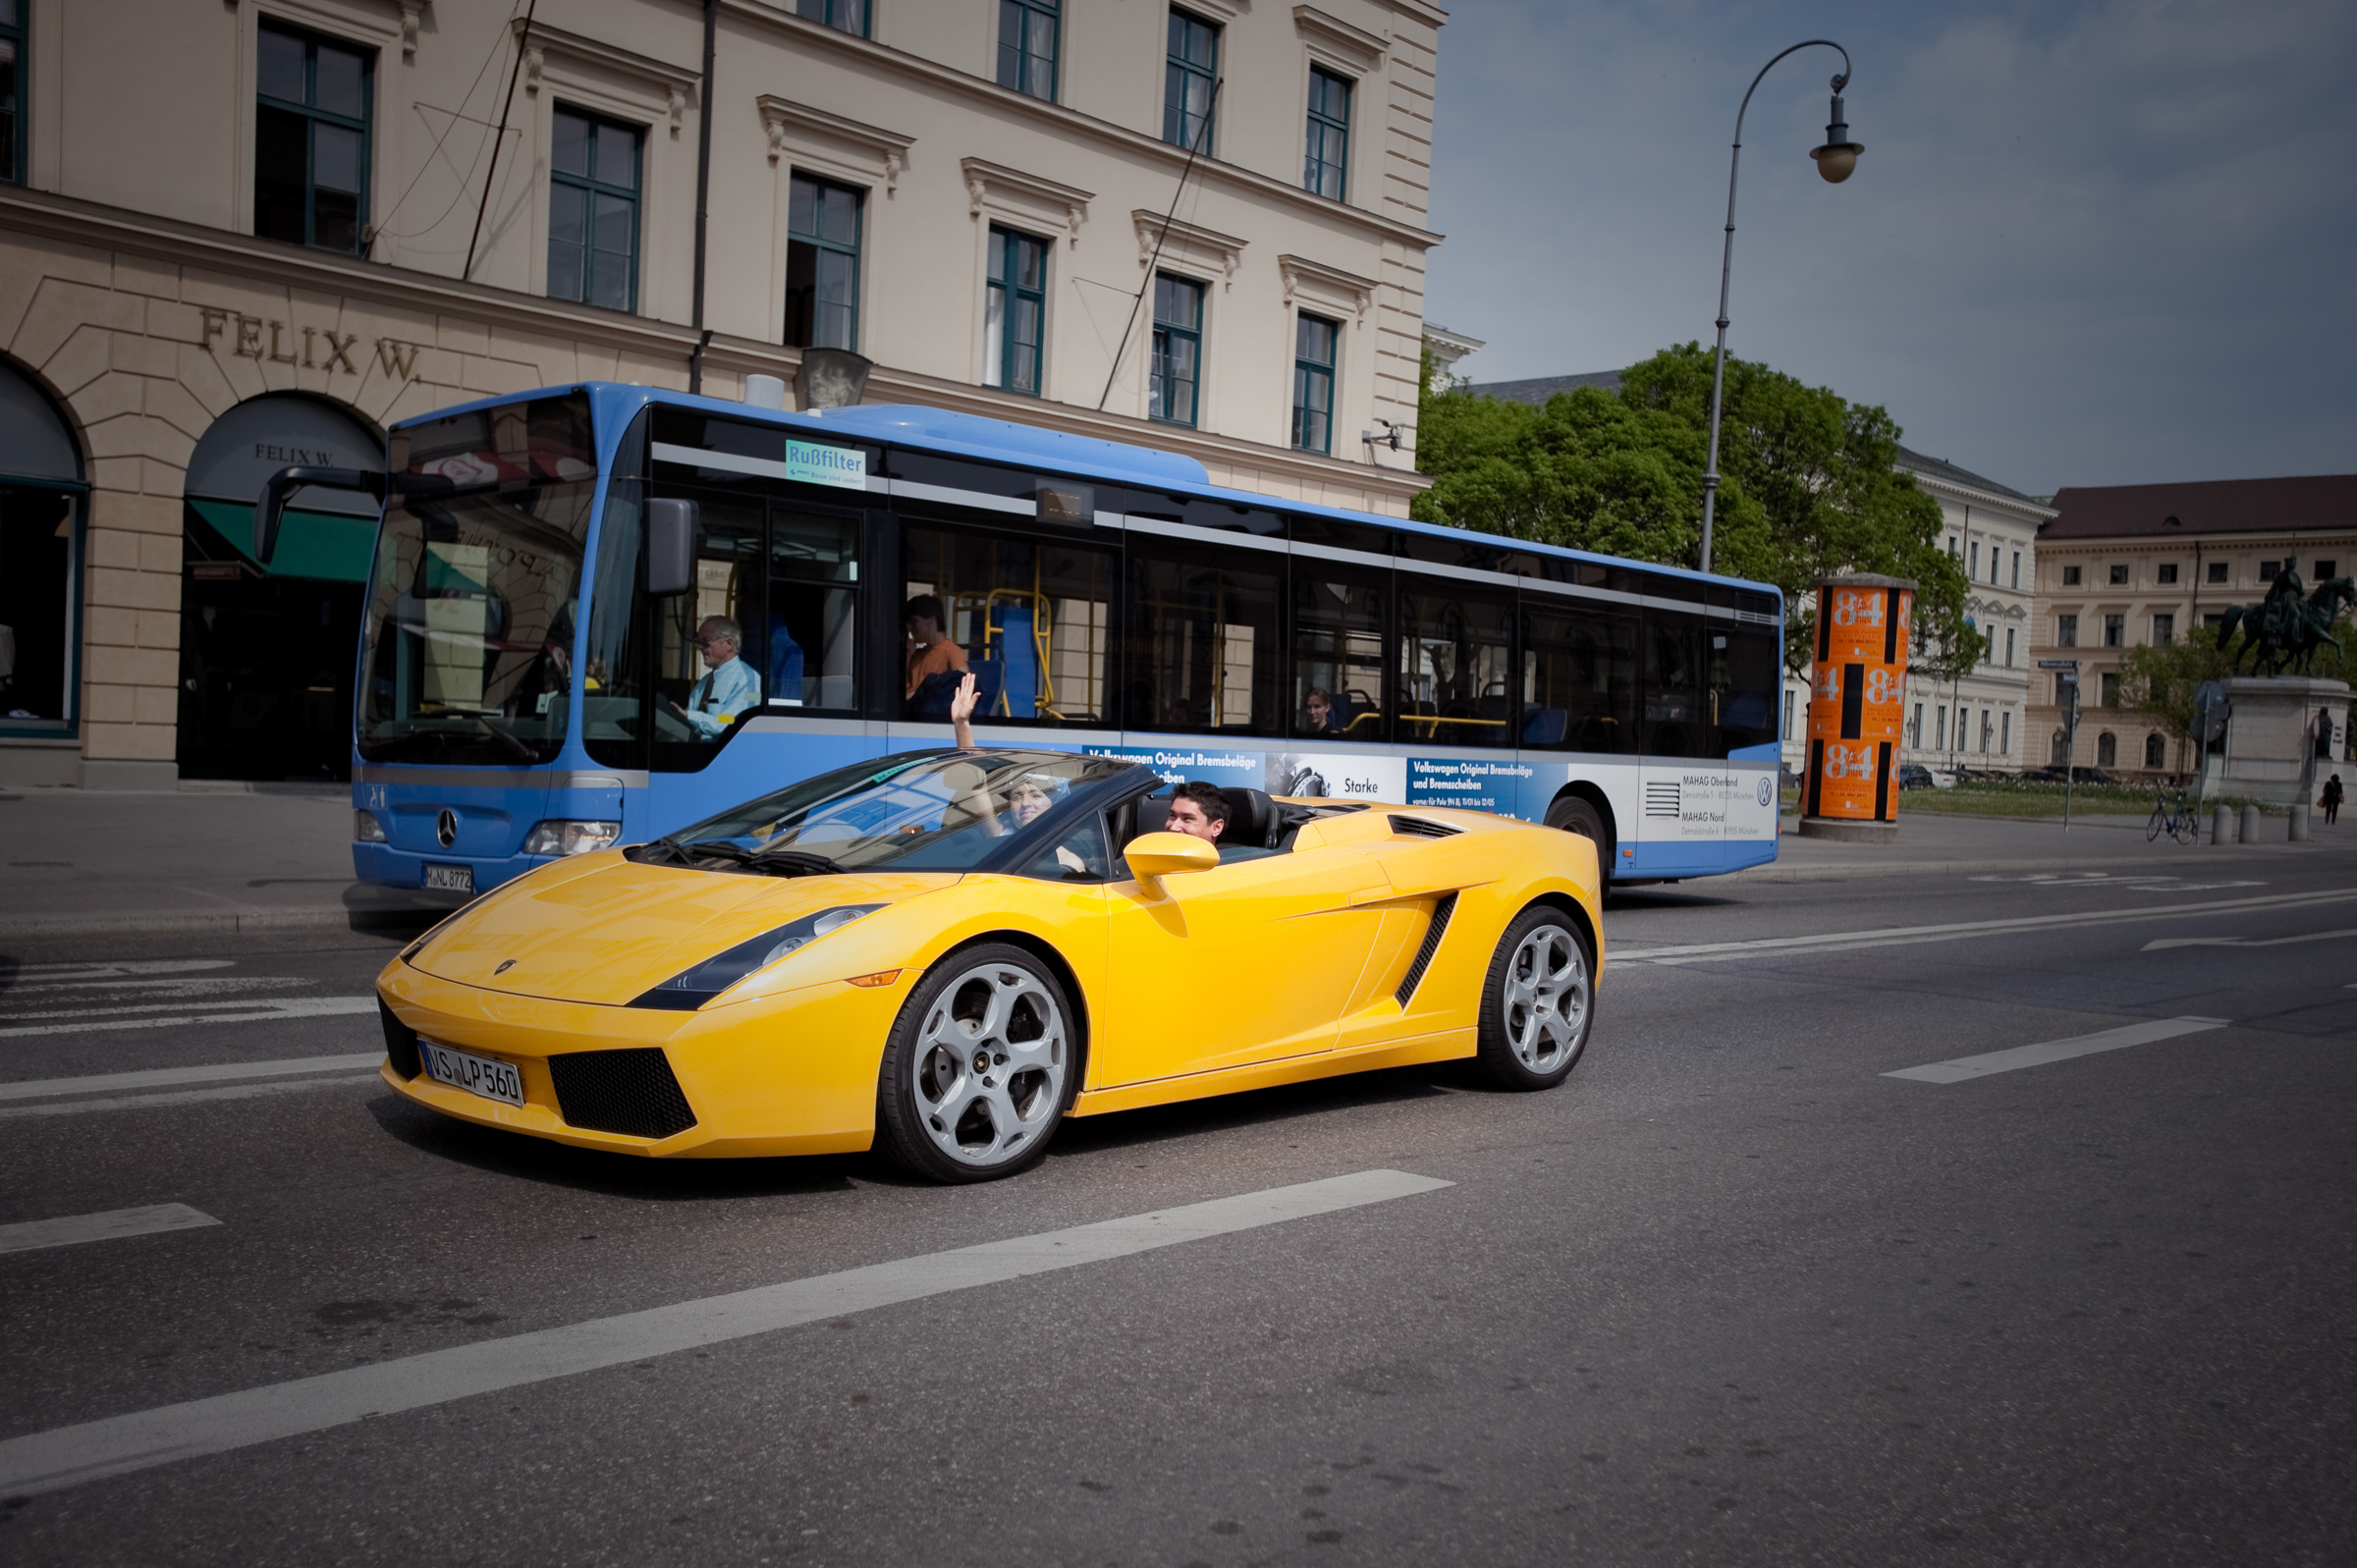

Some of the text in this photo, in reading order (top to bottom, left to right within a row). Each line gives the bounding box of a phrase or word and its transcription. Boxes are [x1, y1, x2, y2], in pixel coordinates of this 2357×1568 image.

[198, 306, 421, 385] FELIX W.
[255, 444, 309, 464] FELIX
[790, 446, 862, 471] Rußfilter
[1835, 591, 1884, 627] 84
[1900, 596, 1911, 630] 8
[1867, 669, 1903, 706] 84
[1155, 751, 1195, 769] Original
[1196, 753, 1257, 771] Bremsbeläge
[1413, 761, 1533, 779] Volkswagen Original Bremsbeläge
[1825, 744, 1874, 781] 84
[1344, 778, 1378, 793] Starke
[1413, 777, 1482, 790] und Bremsscheiben
[1682, 776, 1738, 786] MAHAG Oberland
[1437, 797, 1447, 806] Polo
[1481, 797, 1495, 807] 12/05
[1733, 791, 1754, 800] München
[1681, 812, 1725, 823] MAHAG Nord
[1738, 827, 1759, 836] München
[436, 869, 448, 887] NL
[449, 870, 471, 889] 8772
[427, 1047, 519, 1100] VS LP 560
